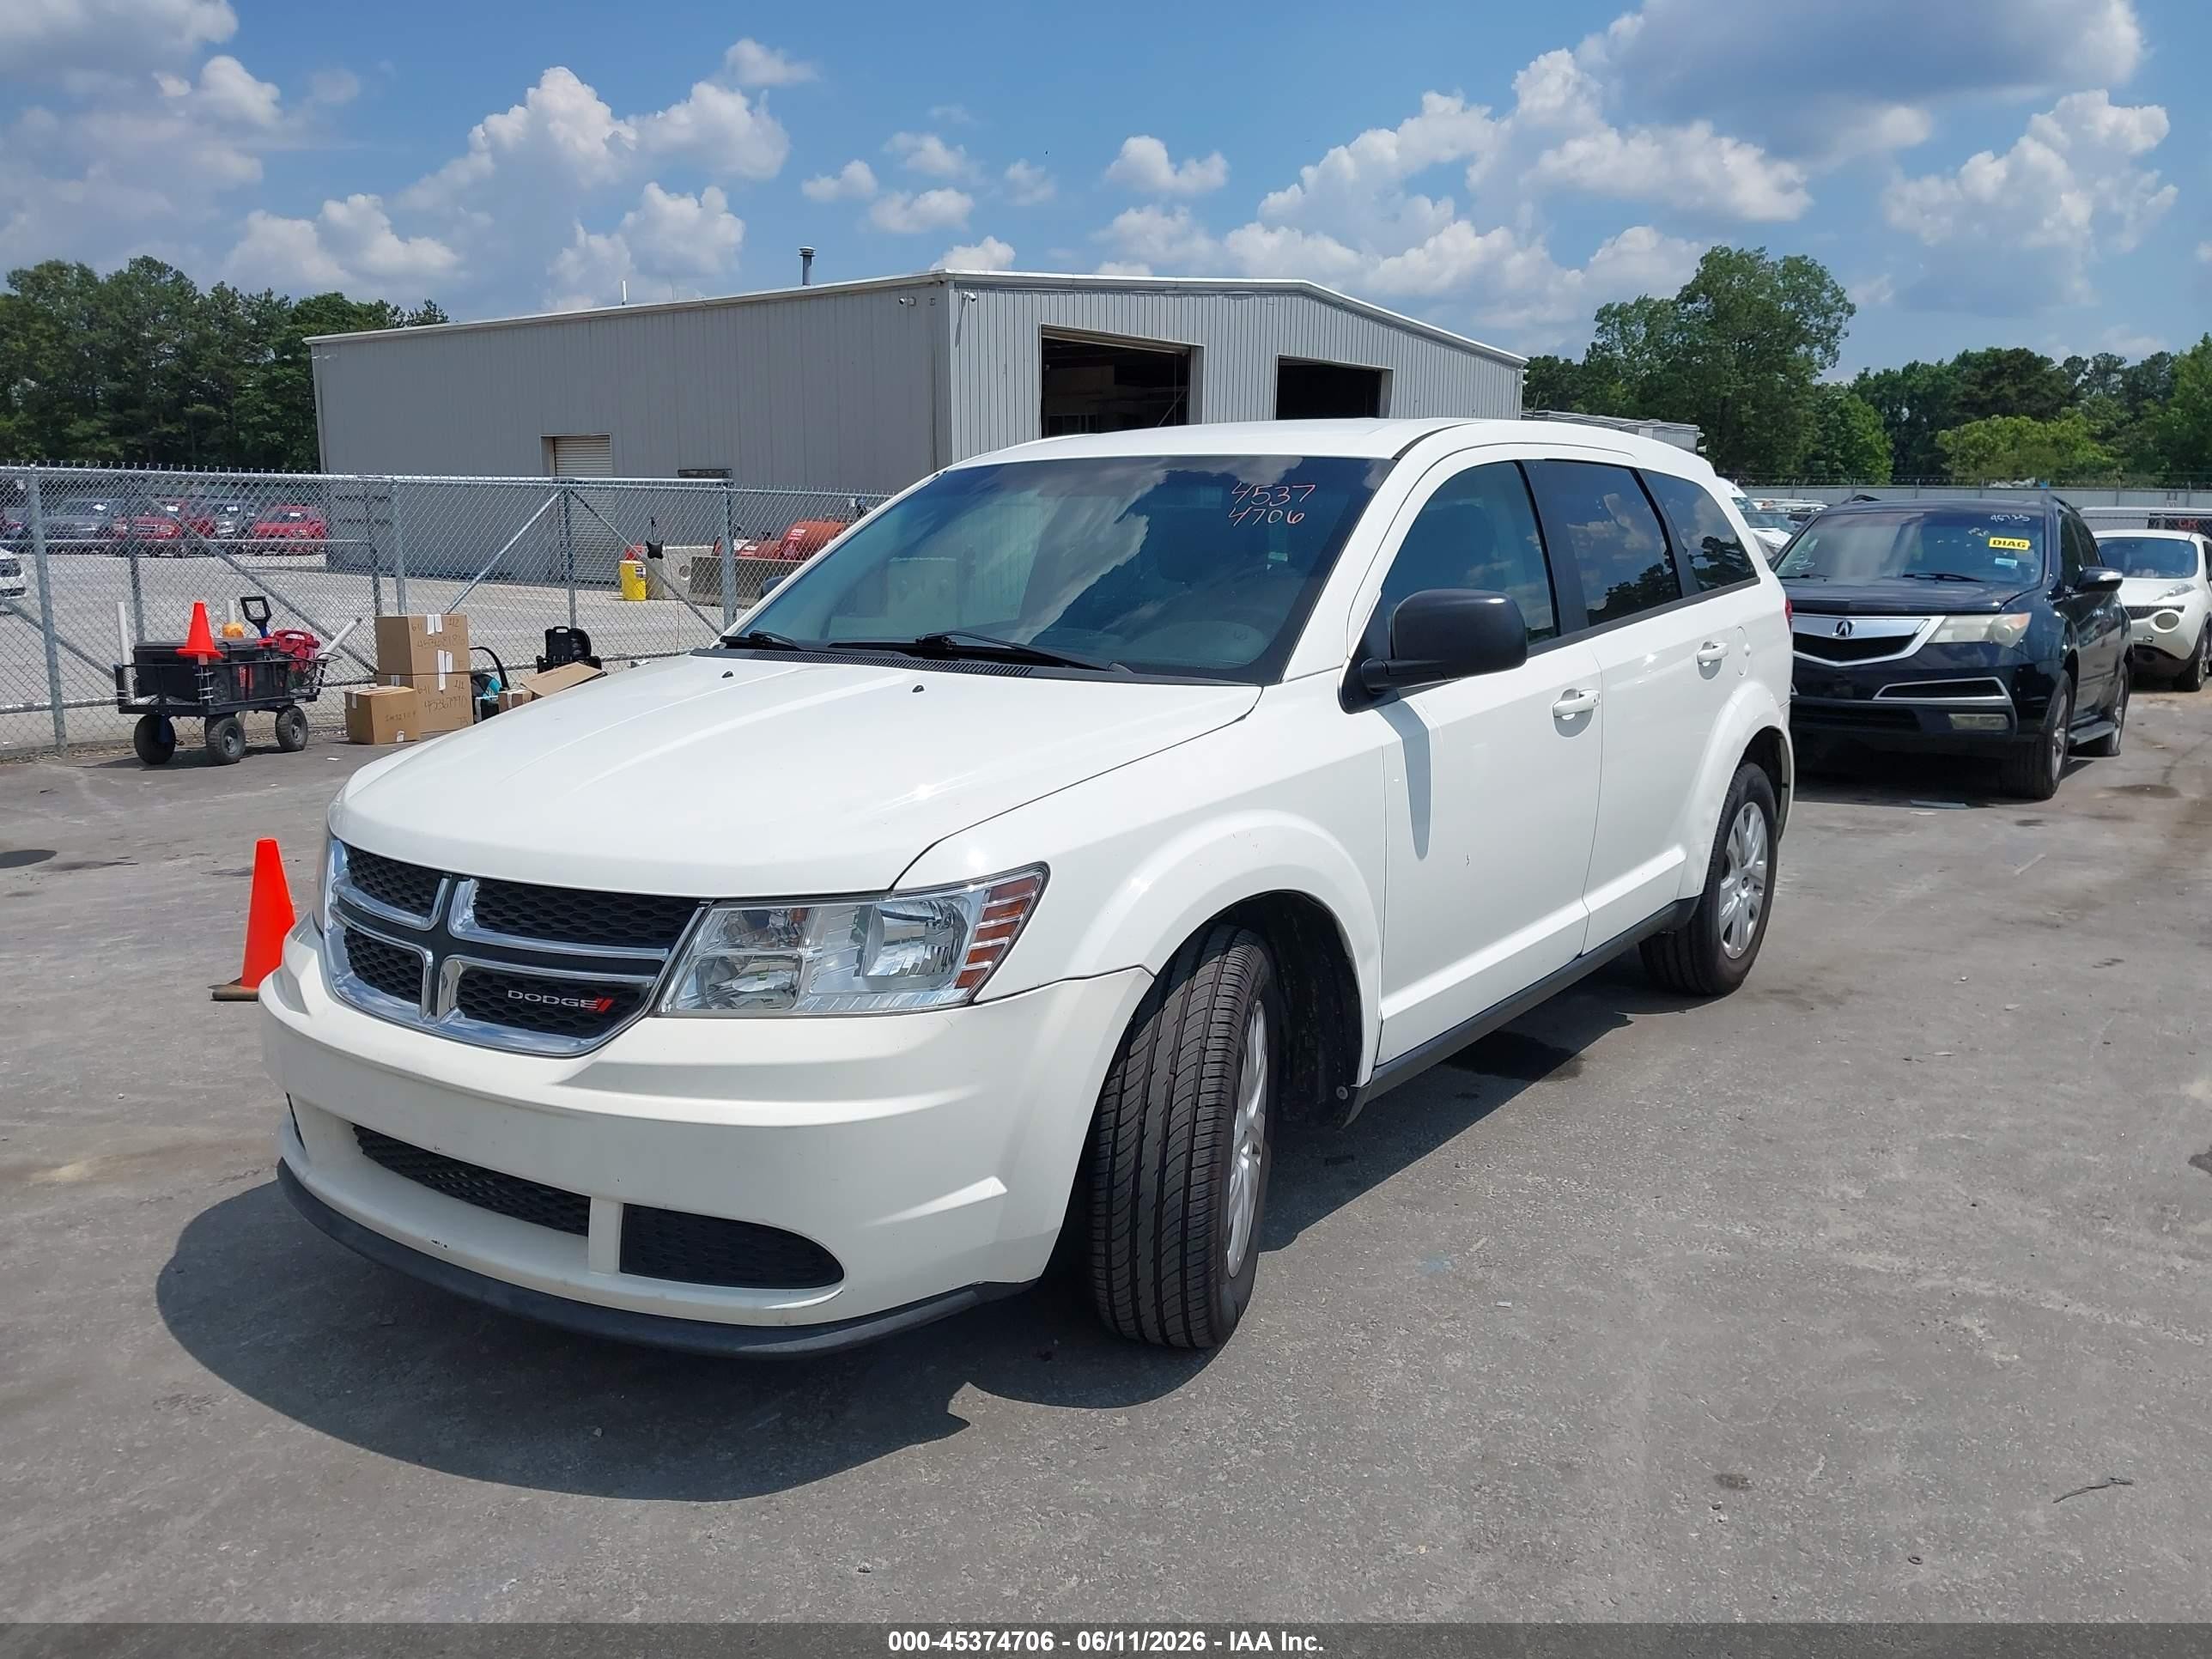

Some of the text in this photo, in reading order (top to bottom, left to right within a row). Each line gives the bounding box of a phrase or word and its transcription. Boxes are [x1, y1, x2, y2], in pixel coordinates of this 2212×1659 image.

[1231, 482, 1316, 507] 4537
[1229, 507, 1305, 527] 4706
[1992, 539, 2027, 549] DIAG
[507, 990, 599, 1009] DODGE
